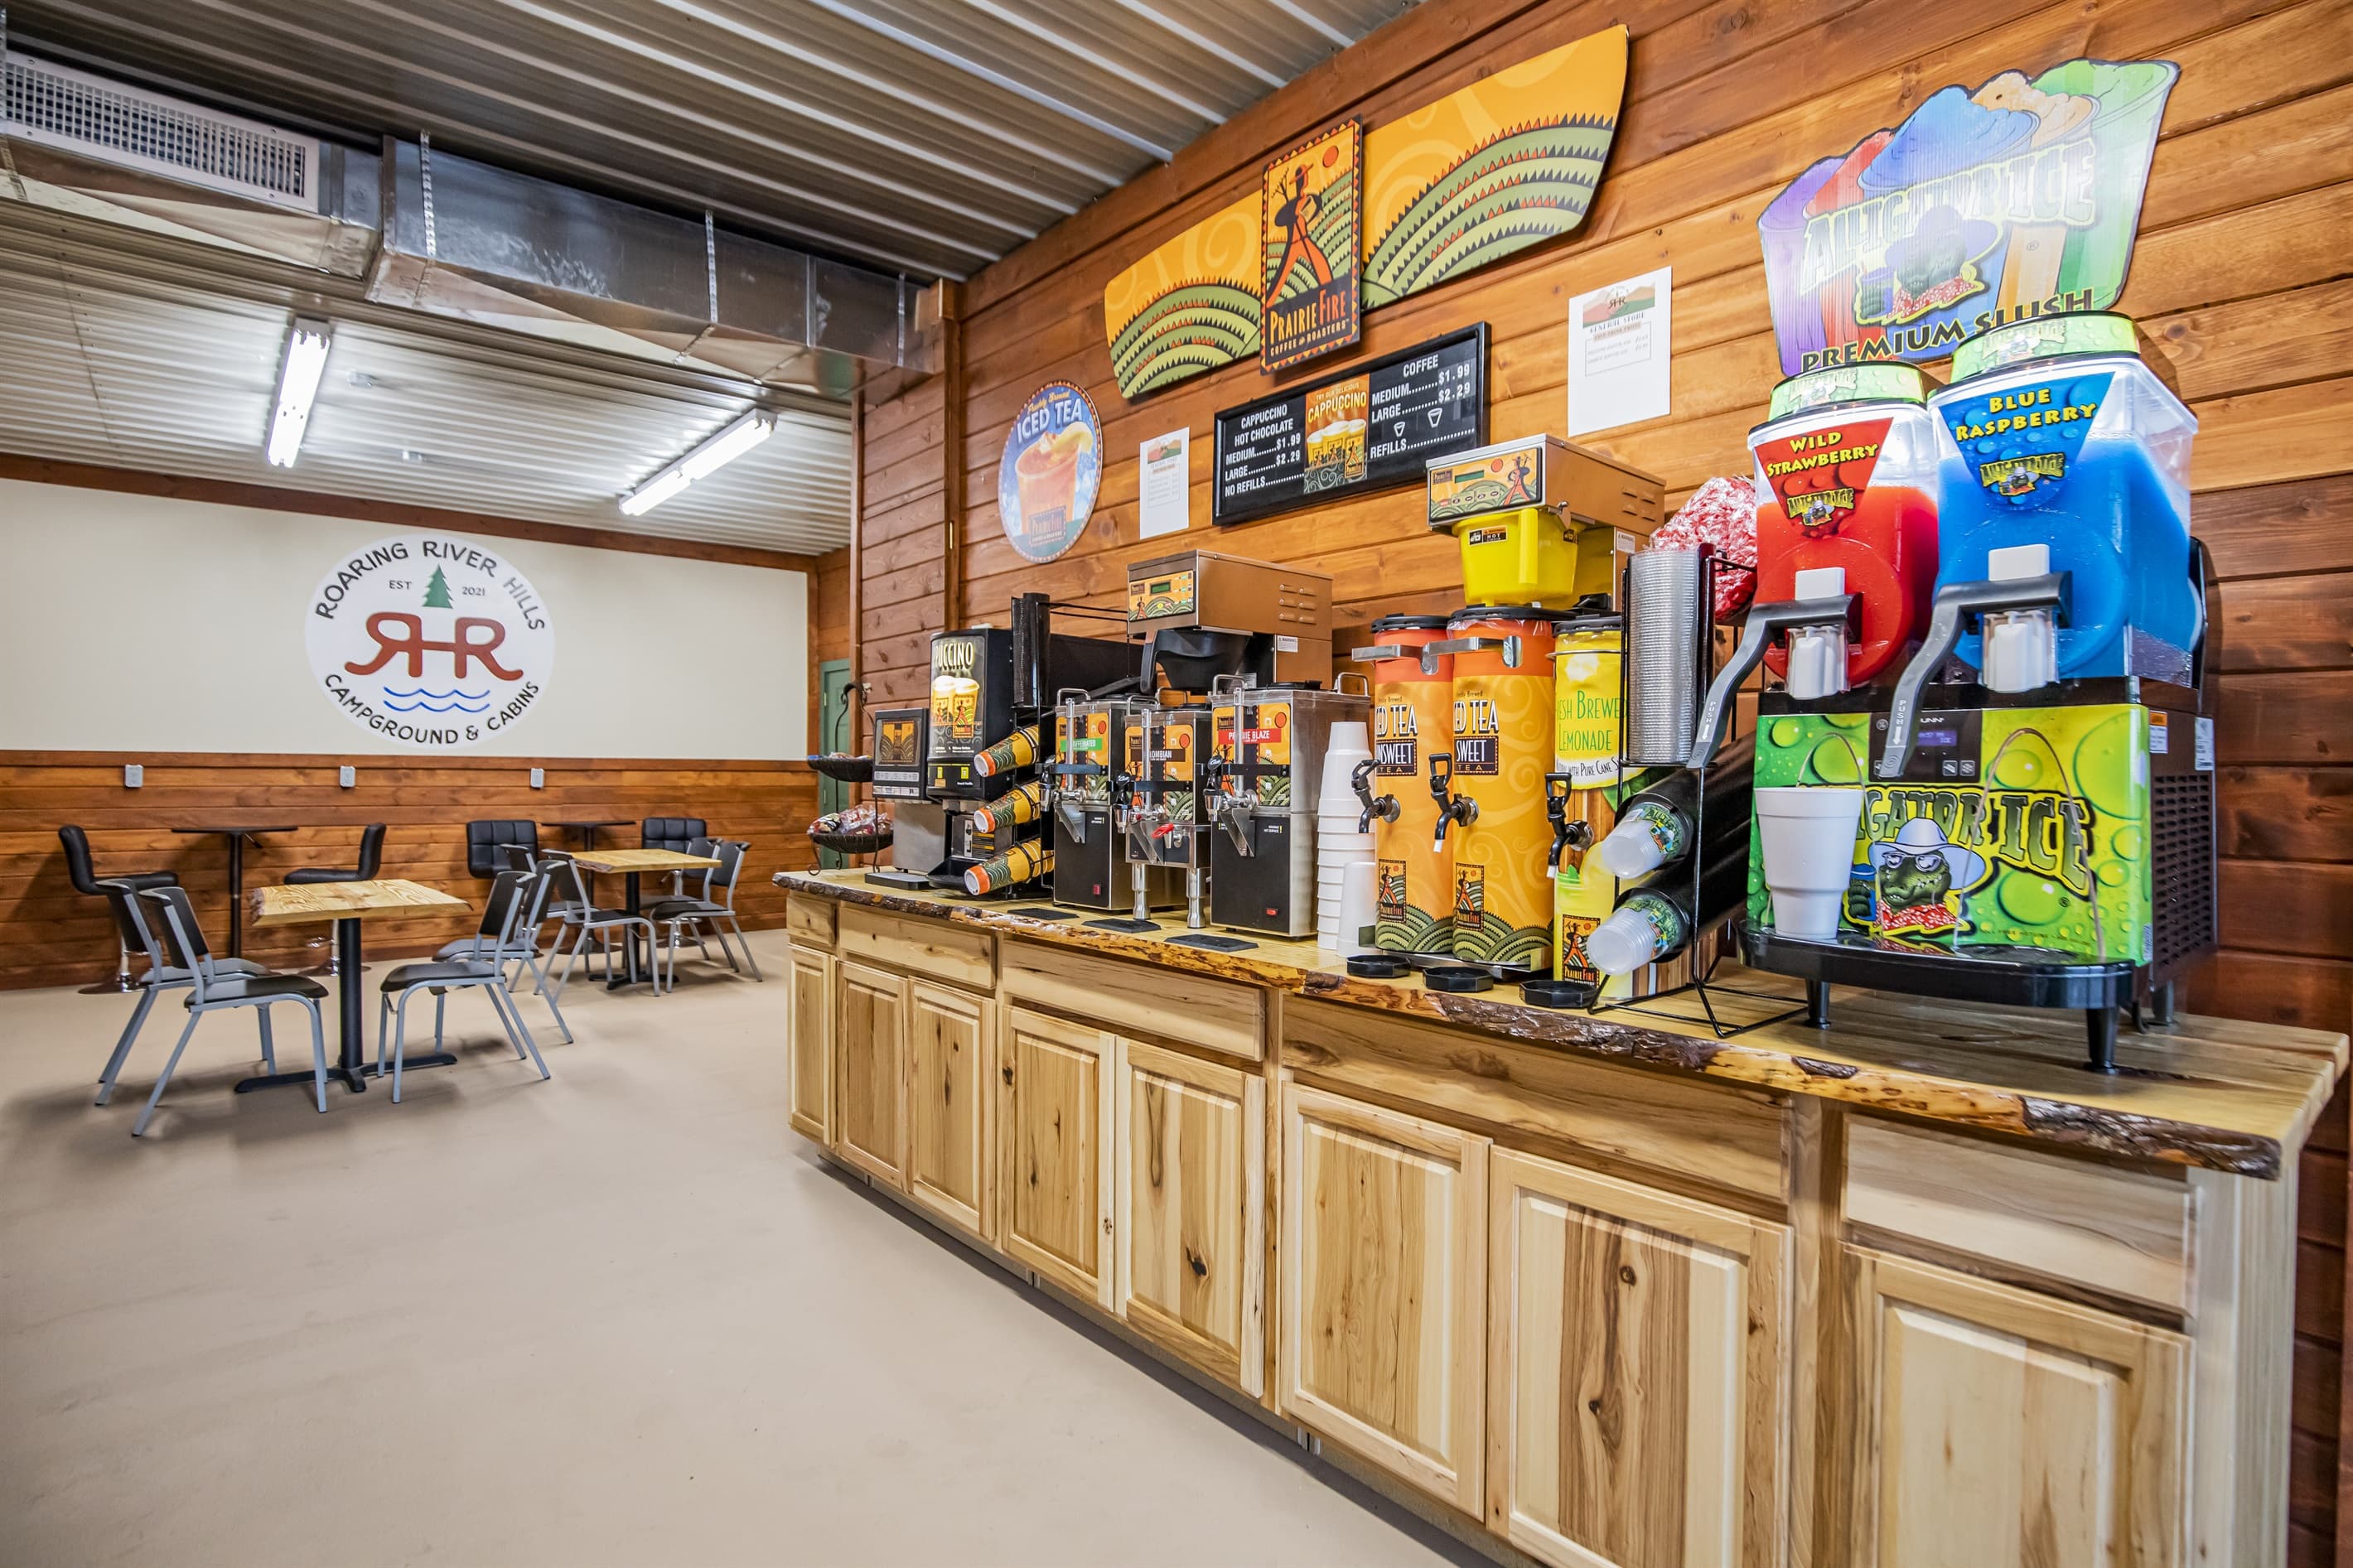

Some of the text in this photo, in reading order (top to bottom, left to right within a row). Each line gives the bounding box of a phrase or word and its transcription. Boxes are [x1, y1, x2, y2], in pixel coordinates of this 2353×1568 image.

[1270, 290, 1346, 345] PRAIRIE FIRE
[1801, 319, 1966, 373] PREMIUM
[1974, 288, 2095, 332] SLUSH
[1270, 320, 1346, 357] COFFEE ROASTERS
[1403, 355, 1438, 378] COFFEE
[1372, 364, 1470, 406] MEDIUM $1.99
[1307, 391, 1367, 423] CAPPUCCINO
[1371, 382, 1470, 424] LARGE $2.29
[1989, 388, 2051, 414] BLUE
[1017, 398, 1083, 445] ICED TEA
[1241, 404, 1288, 429] CAPPUCCINO
[1955, 403, 2097, 441] RASPBERRY
[1234, 418, 1293, 446] HOT CHOCOLATE
[1789, 432, 1843, 454] WILD
[1225, 432, 1301, 466] MEDIUM $1.99
[1370, 438, 1407, 459] REFILLS
[1766, 443, 1879, 478] STRAWBERRY
[1225, 450, 1301, 482] LARGE $2.29
[1225, 475, 1266, 497] NO REFILLS
[315, 541, 545, 630] ROARING RIVER HILLS
[389, 580, 413, 591] EST
[461, 586, 486, 597] 2021
[325, 674, 539, 745] CAMPGROUND & CABINS
[1470, 699, 1499, 734] TEA
[1577, 690, 1625, 719] BREWE
[1706, 701, 1717, 723] PUSH
[1896, 700, 1907, 725] PUSH
[1390, 704, 1418, 736] TEA
[1252, 730, 1270, 740] BLAZE
[1558, 722, 1612, 751] LEMONADE
[1379, 742, 1413, 765] NSWEET
[1456, 740, 1487, 762] SWEET
[1580, 762, 1596, 776] PURE
[1596, 760, 1612, 774] CANE
[1999, 795, 2088, 890] ICE
